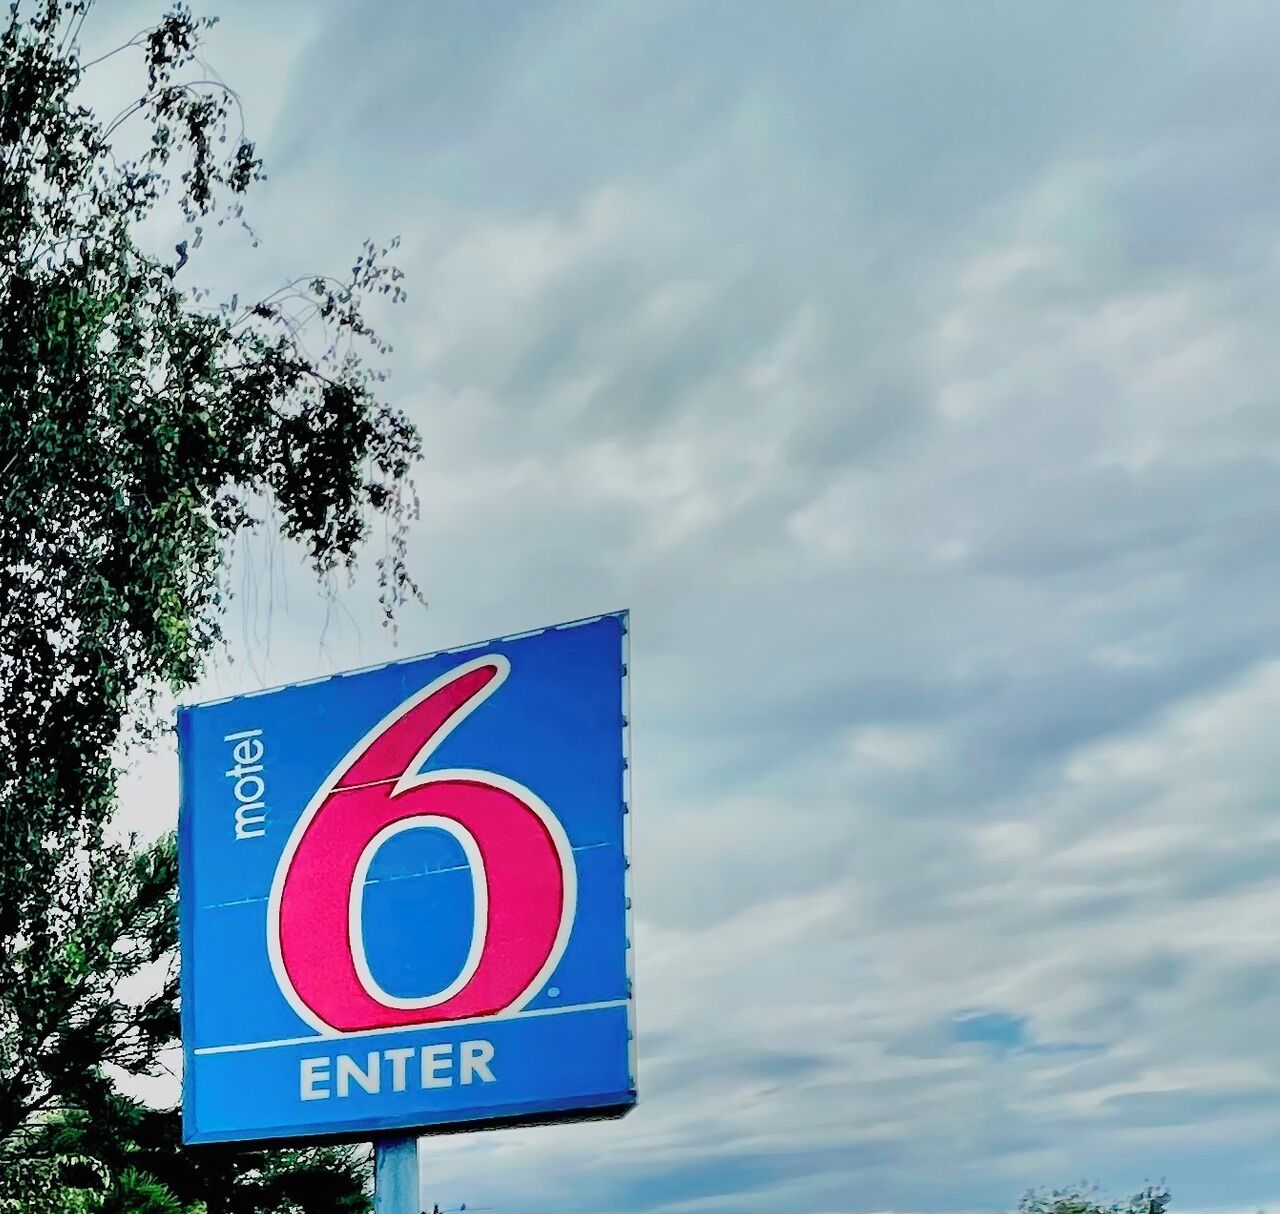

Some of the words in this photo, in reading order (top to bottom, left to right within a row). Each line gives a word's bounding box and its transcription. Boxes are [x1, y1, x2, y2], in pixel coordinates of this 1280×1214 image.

[224, 729, 265, 840] motel
[267, 653, 578, 1036] 6
[300, 1040, 497, 1101] ENTER
